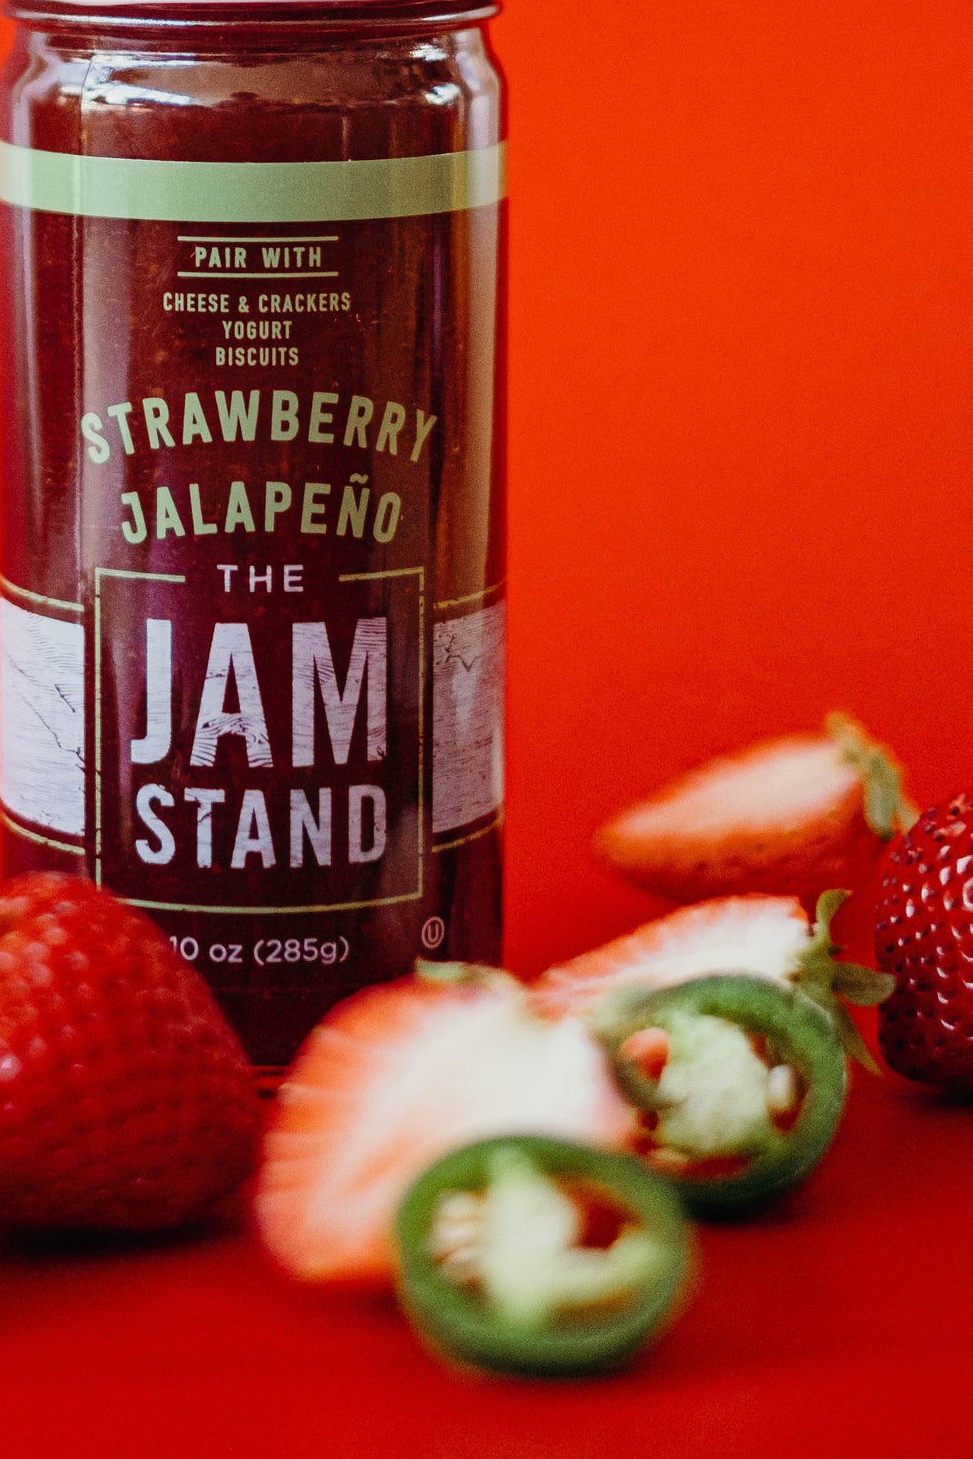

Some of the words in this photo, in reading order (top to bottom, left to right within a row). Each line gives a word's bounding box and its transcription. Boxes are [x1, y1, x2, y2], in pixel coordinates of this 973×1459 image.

[193, 246, 247, 269] PAIR
[261, 246, 322, 269] WITH
[162, 291, 230, 313] CHEESE
[237, 295, 250, 313] &
[257, 291, 352, 313] CRACKERS
[221, 319, 293, 341] YOGURT
[214, 346, 300, 367] BISCUITS
[80, 389, 438, 465] STRAWBERRY
[120, 472, 402, 545] JALAPEÑO
[216, 563, 305, 593] THE
[130, 617, 388, 768] JAM
[134, 782, 387, 869] STAND
[208, 942, 243, 963] oz
[252, 935, 351, 966] (285g)
